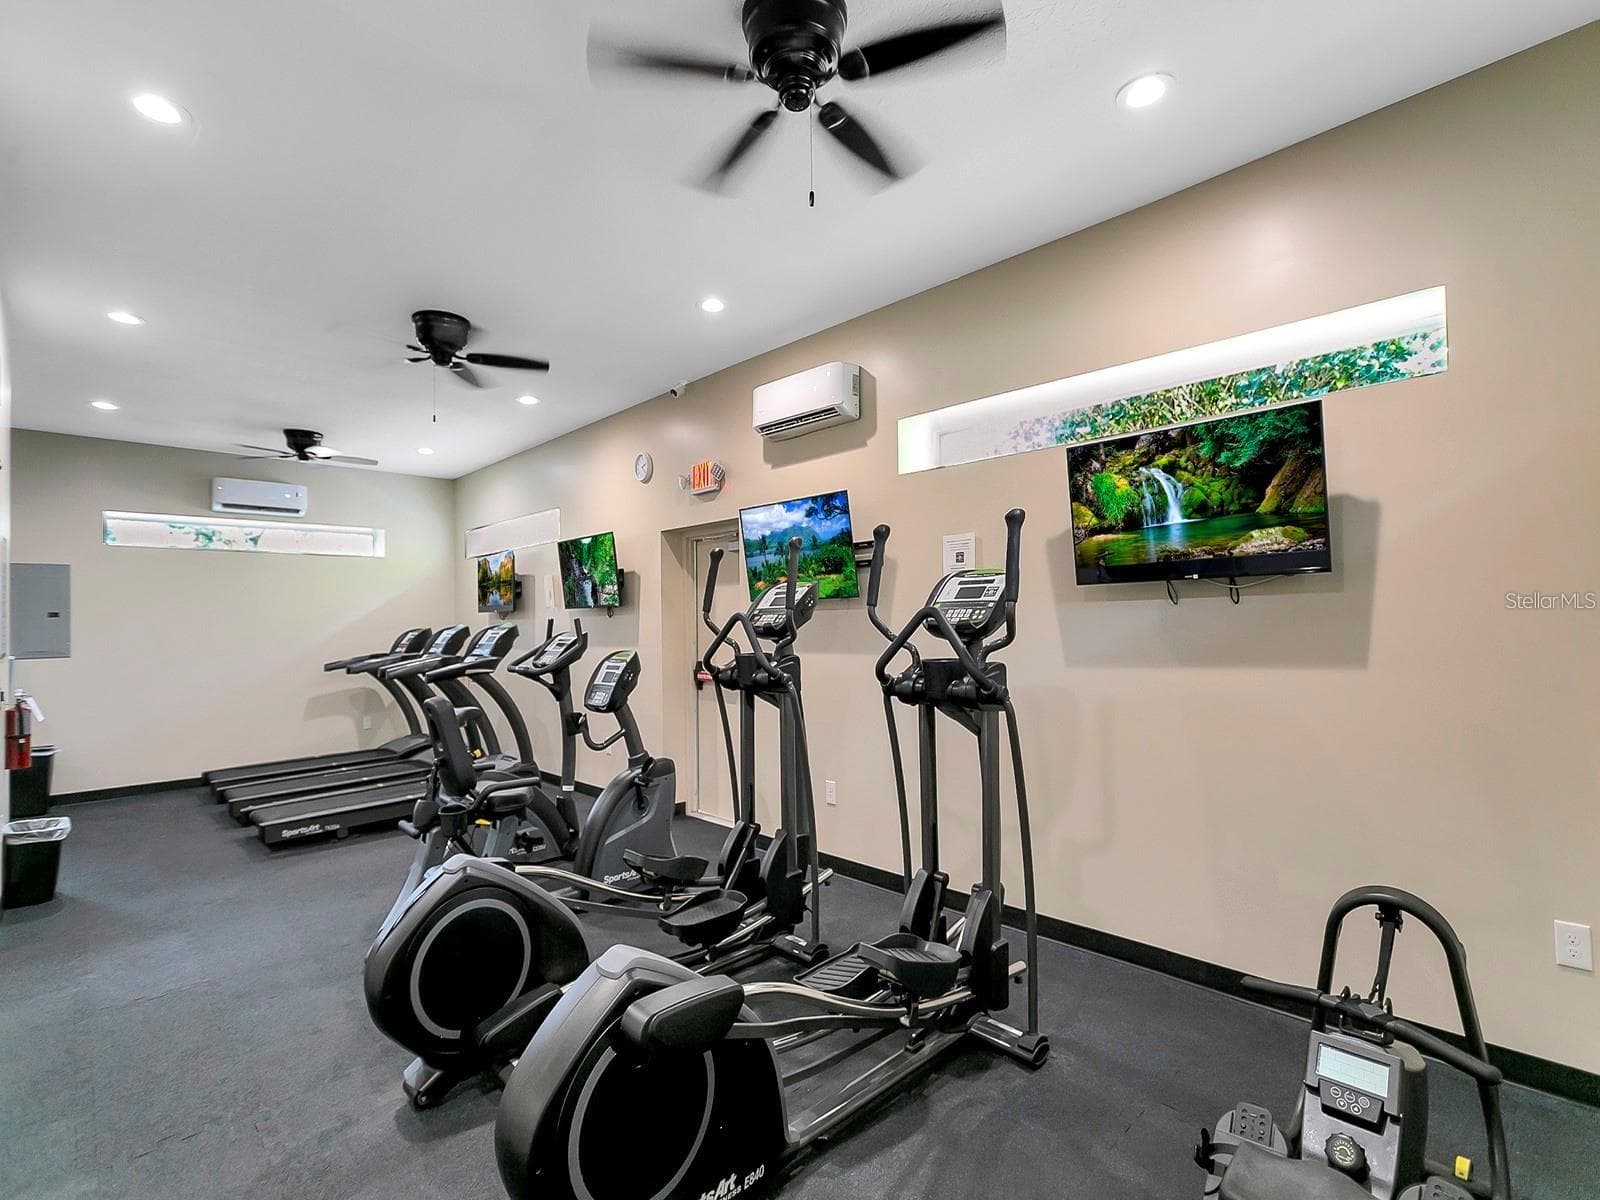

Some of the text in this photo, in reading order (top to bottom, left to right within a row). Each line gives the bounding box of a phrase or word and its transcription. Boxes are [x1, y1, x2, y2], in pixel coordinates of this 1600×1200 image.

[690, 460, 713, 490] EXIT
[603, 869, 639, 884] SportsA
[743, 1163, 765, 1190] E840
